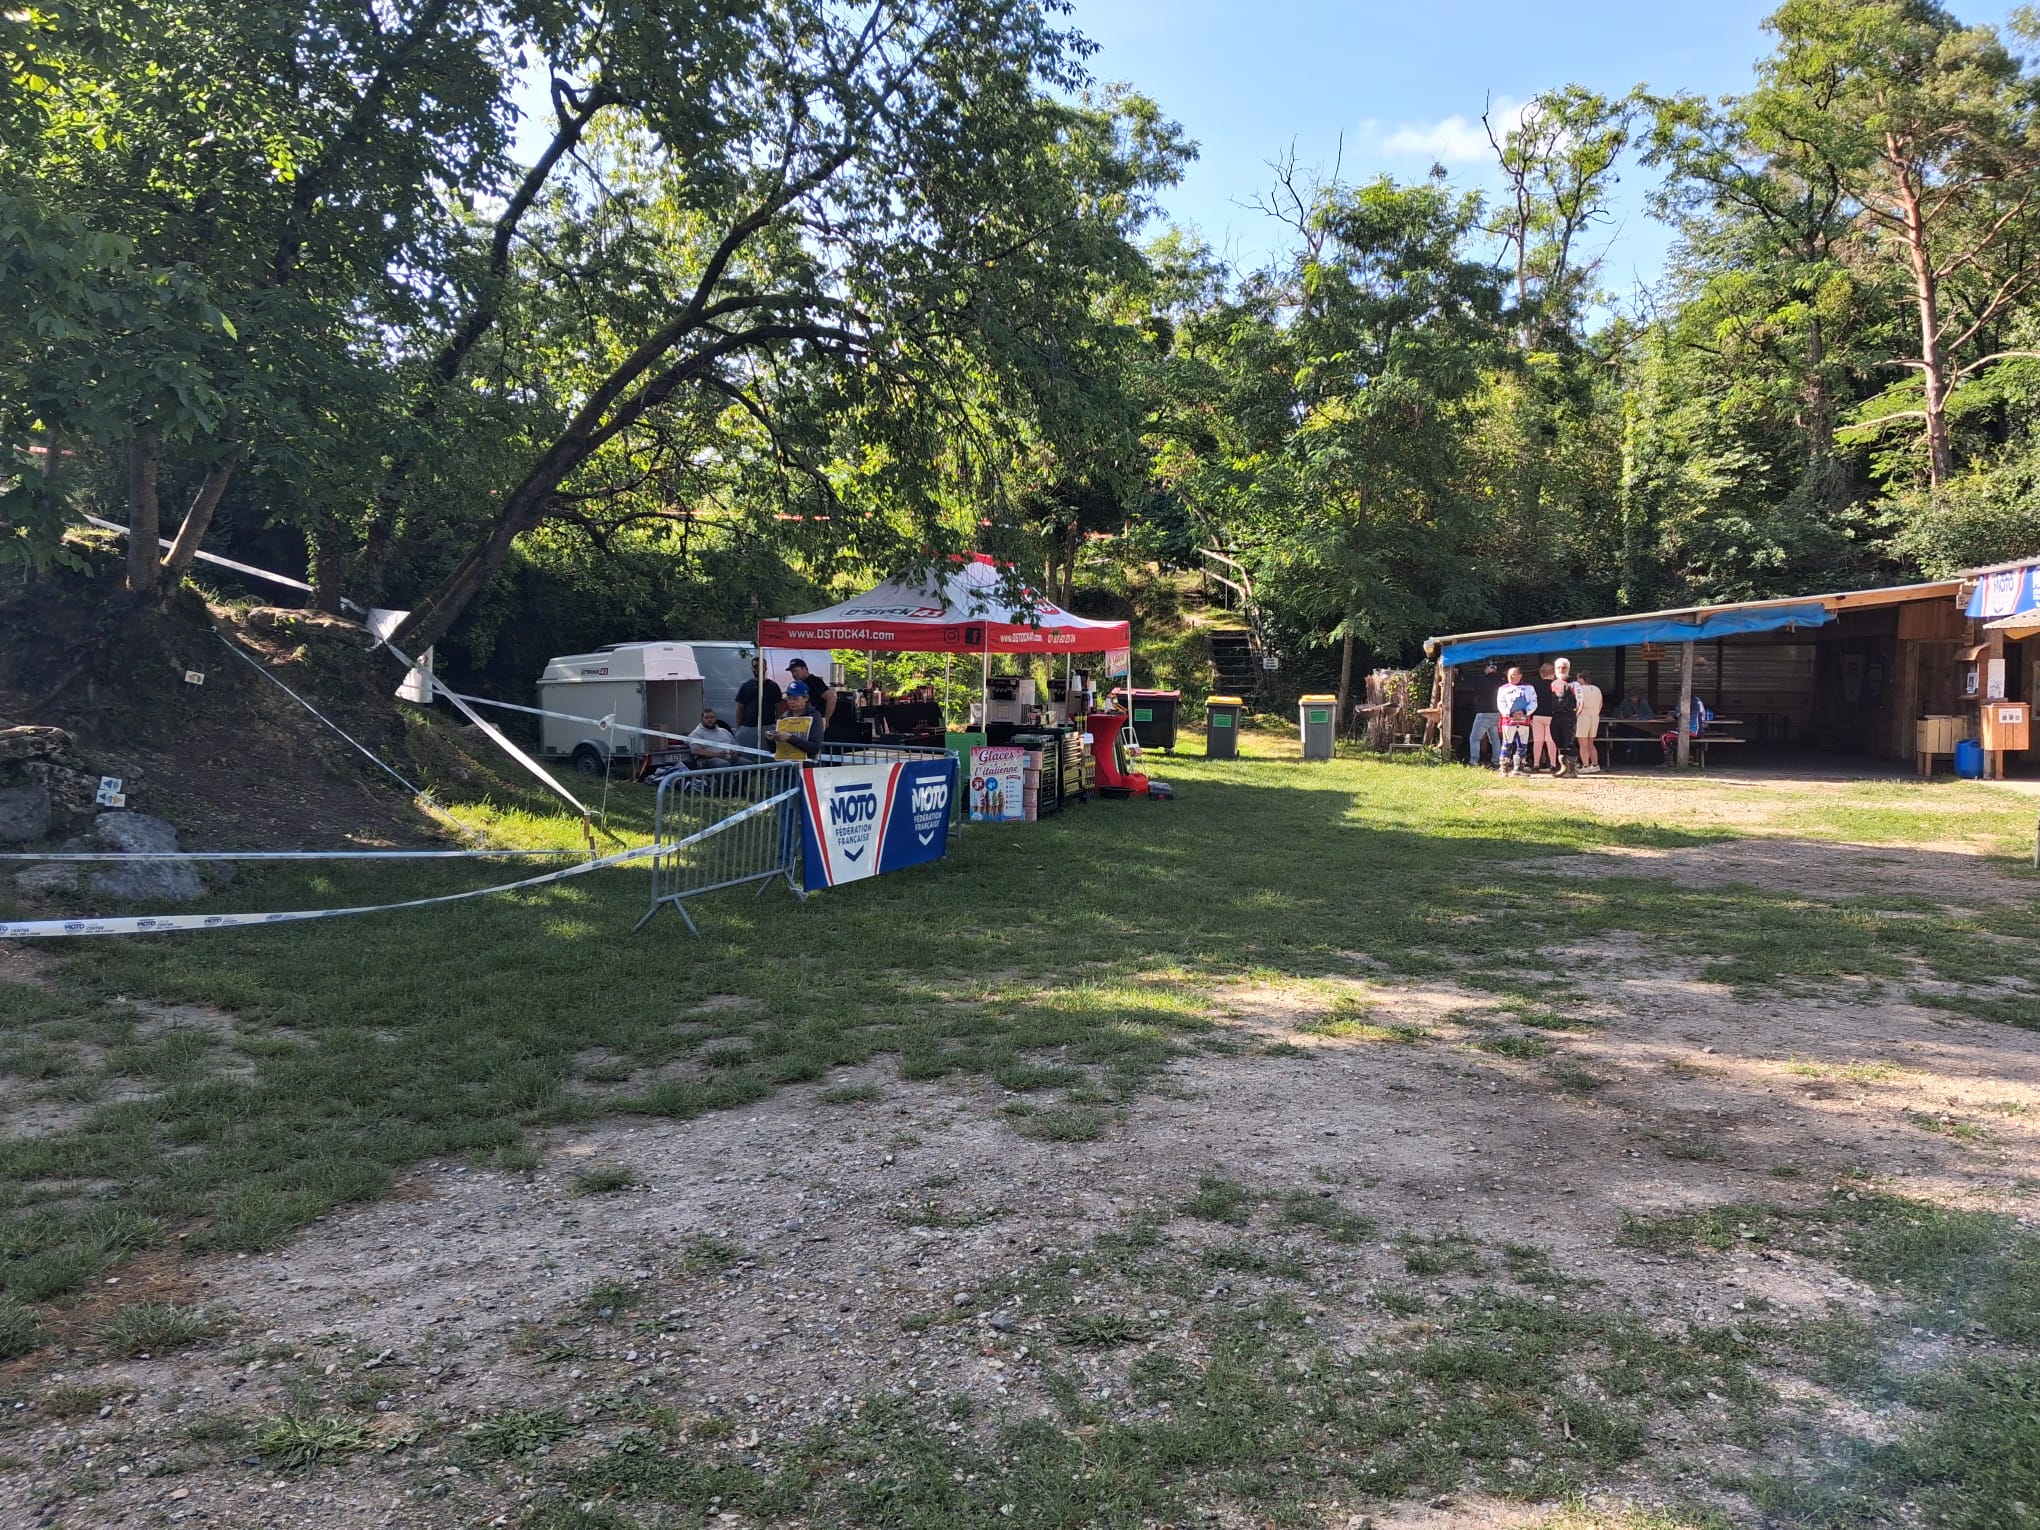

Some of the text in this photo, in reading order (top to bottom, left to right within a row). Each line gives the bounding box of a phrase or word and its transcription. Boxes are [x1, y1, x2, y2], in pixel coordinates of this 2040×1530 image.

[787, 627, 895, 641] www.DSTOCK41.com
[979, 750, 1014, 765] Glaces
[911, 783, 948, 814] MOTO
[829, 792, 877, 826] MOTO
[835, 823, 872, 838] FÉDÉRATION
[838, 833, 870, 846] FRANÇAISE
